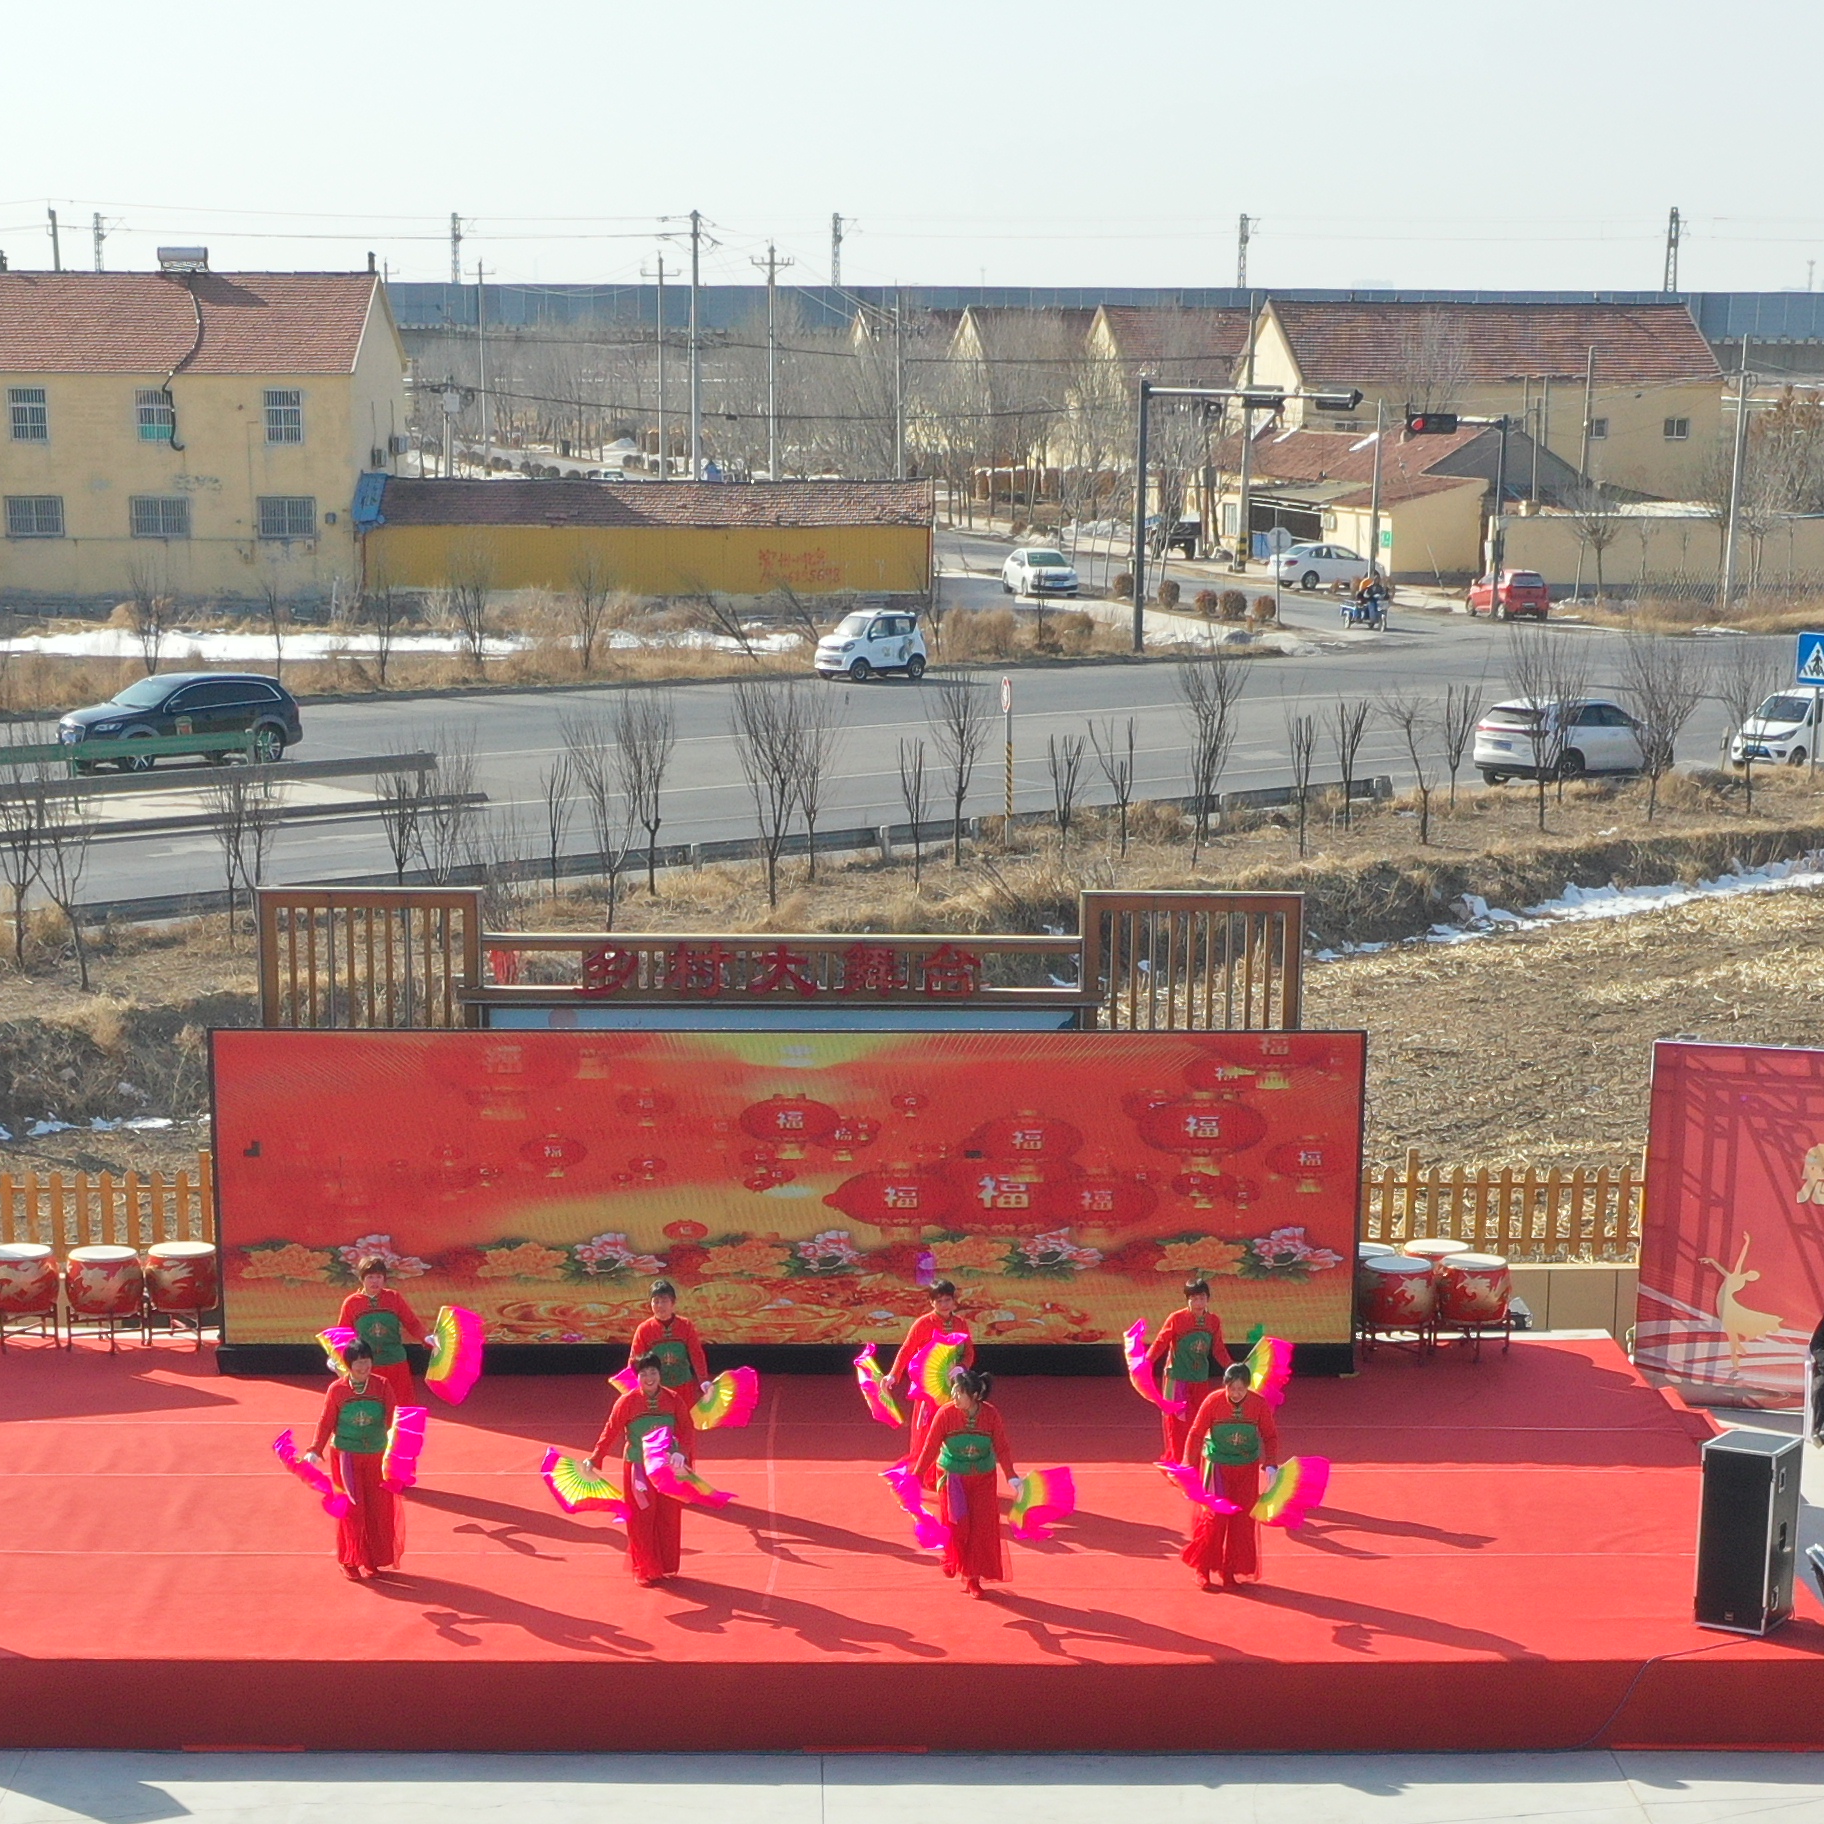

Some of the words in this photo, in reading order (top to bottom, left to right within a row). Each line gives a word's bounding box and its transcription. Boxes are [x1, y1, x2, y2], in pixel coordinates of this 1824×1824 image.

[575, 942, 982, 998] 乡村大舞台
[1184, 1115, 1220, 1139] 福
[1011, 1129, 1044, 1151] 福
[883, 1186, 919, 1209] 福
[976, 1175, 1030, 1209] 福
